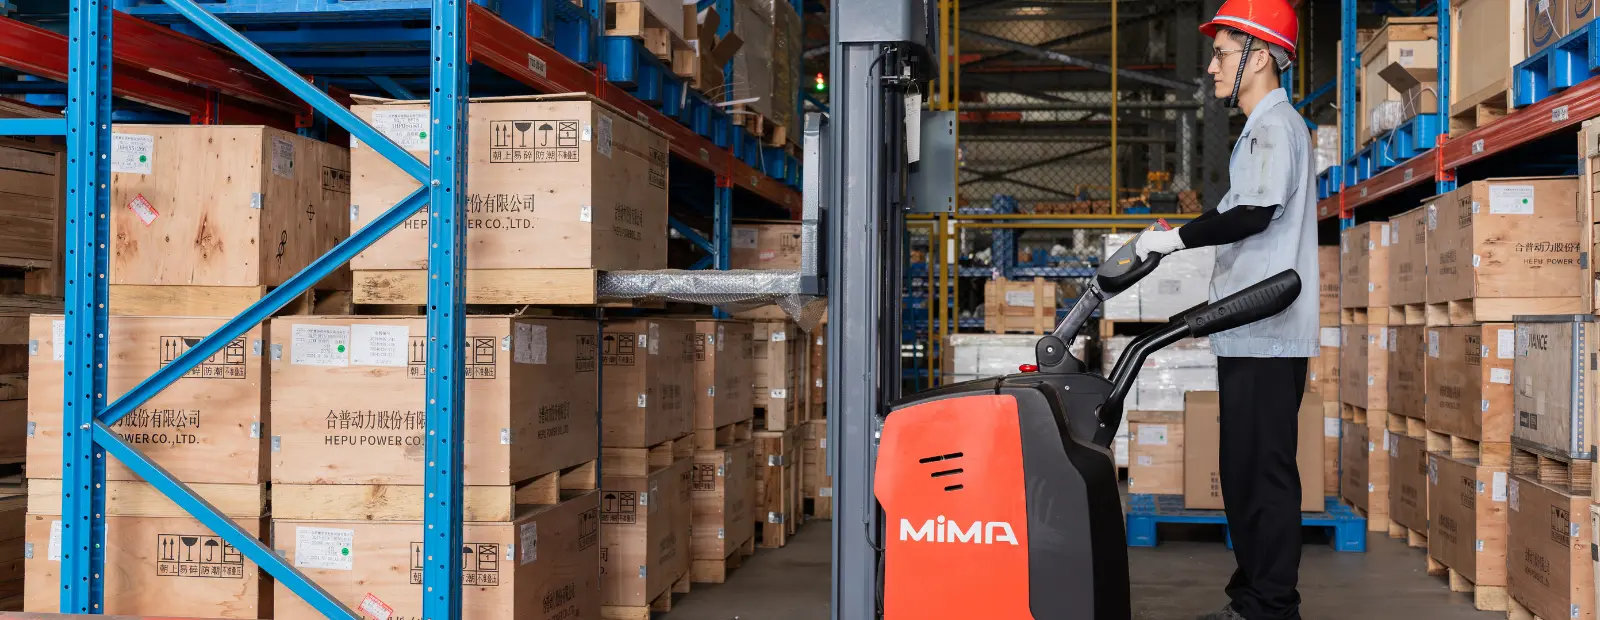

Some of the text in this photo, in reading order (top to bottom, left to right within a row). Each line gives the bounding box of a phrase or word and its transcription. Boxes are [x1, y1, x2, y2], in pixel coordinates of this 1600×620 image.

[514, 150, 532, 160] 易碎
[536, 150, 555, 160] 防潮
[404, 219, 428, 230] HEP
[485, 218, 535, 231] CO.,LTD.
[118, 433, 200, 446] WER CO.,LTD.
[324, 435, 357, 446] HEPU
[360, 435, 402, 446] POWER
[180, 564, 199, 574] 易碎
[201, 565, 220, 575] 防潮
